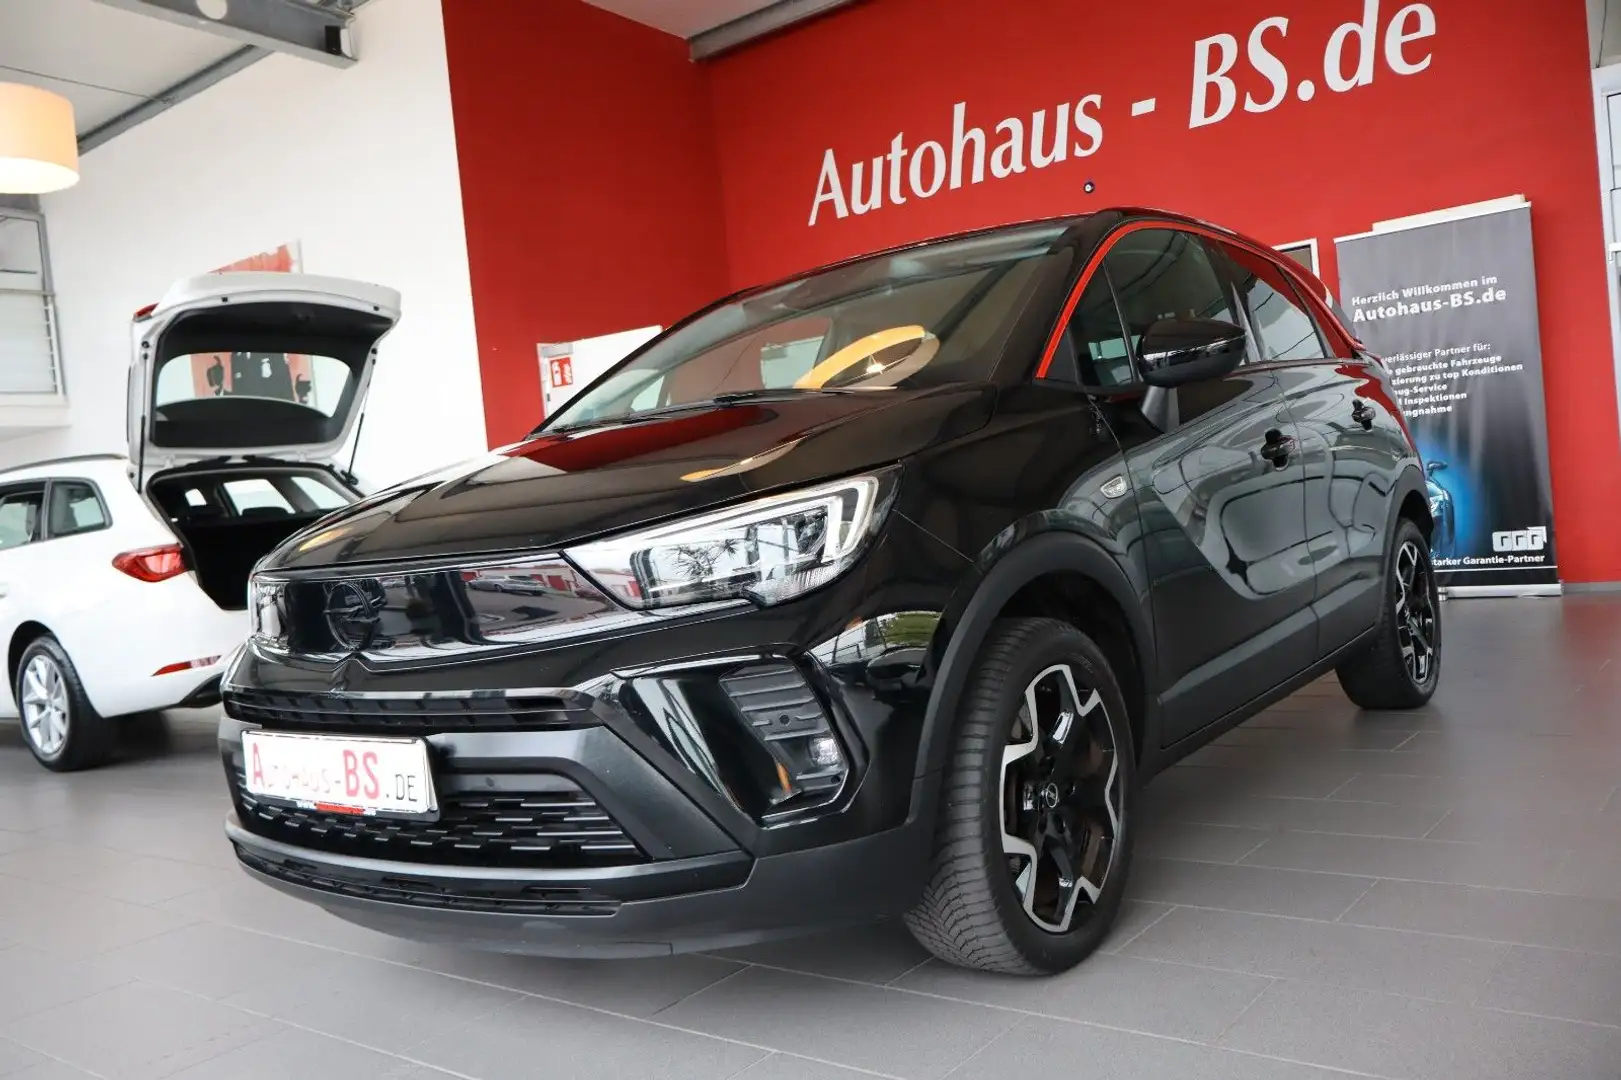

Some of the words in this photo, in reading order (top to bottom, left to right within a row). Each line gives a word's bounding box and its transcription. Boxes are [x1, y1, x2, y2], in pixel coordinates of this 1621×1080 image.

[808, 94, 1102, 226] Autohaus
[1189, 0, 1436, 129] BS.de
[1352, 290, 1399, 306] Herzlich
[1402, 279, 1478, 298] Willkommen
[1481, 275, 1498, 286] im
[1353, 287, 1507, 323] Autohaus-BS.de
[1381, 350, 1432, 364] verlässiger
[1434, 344, 1471, 357] Partner
[1472, 342, 1491, 352] für:
[1391, 375, 1427, 386] zierung
[1429, 373, 1441, 381] zu
[1443, 370, 1460, 381] top
[1461, 363, 1523, 377] Konditionen
[1395, 361, 1448, 376] gebrauchte
[1450, 354, 1502, 369] Fahrzeuge
[1404, 392, 1468, 406] Inspektionen
[1463, 555, 1545, 566] Garantie-Partner
